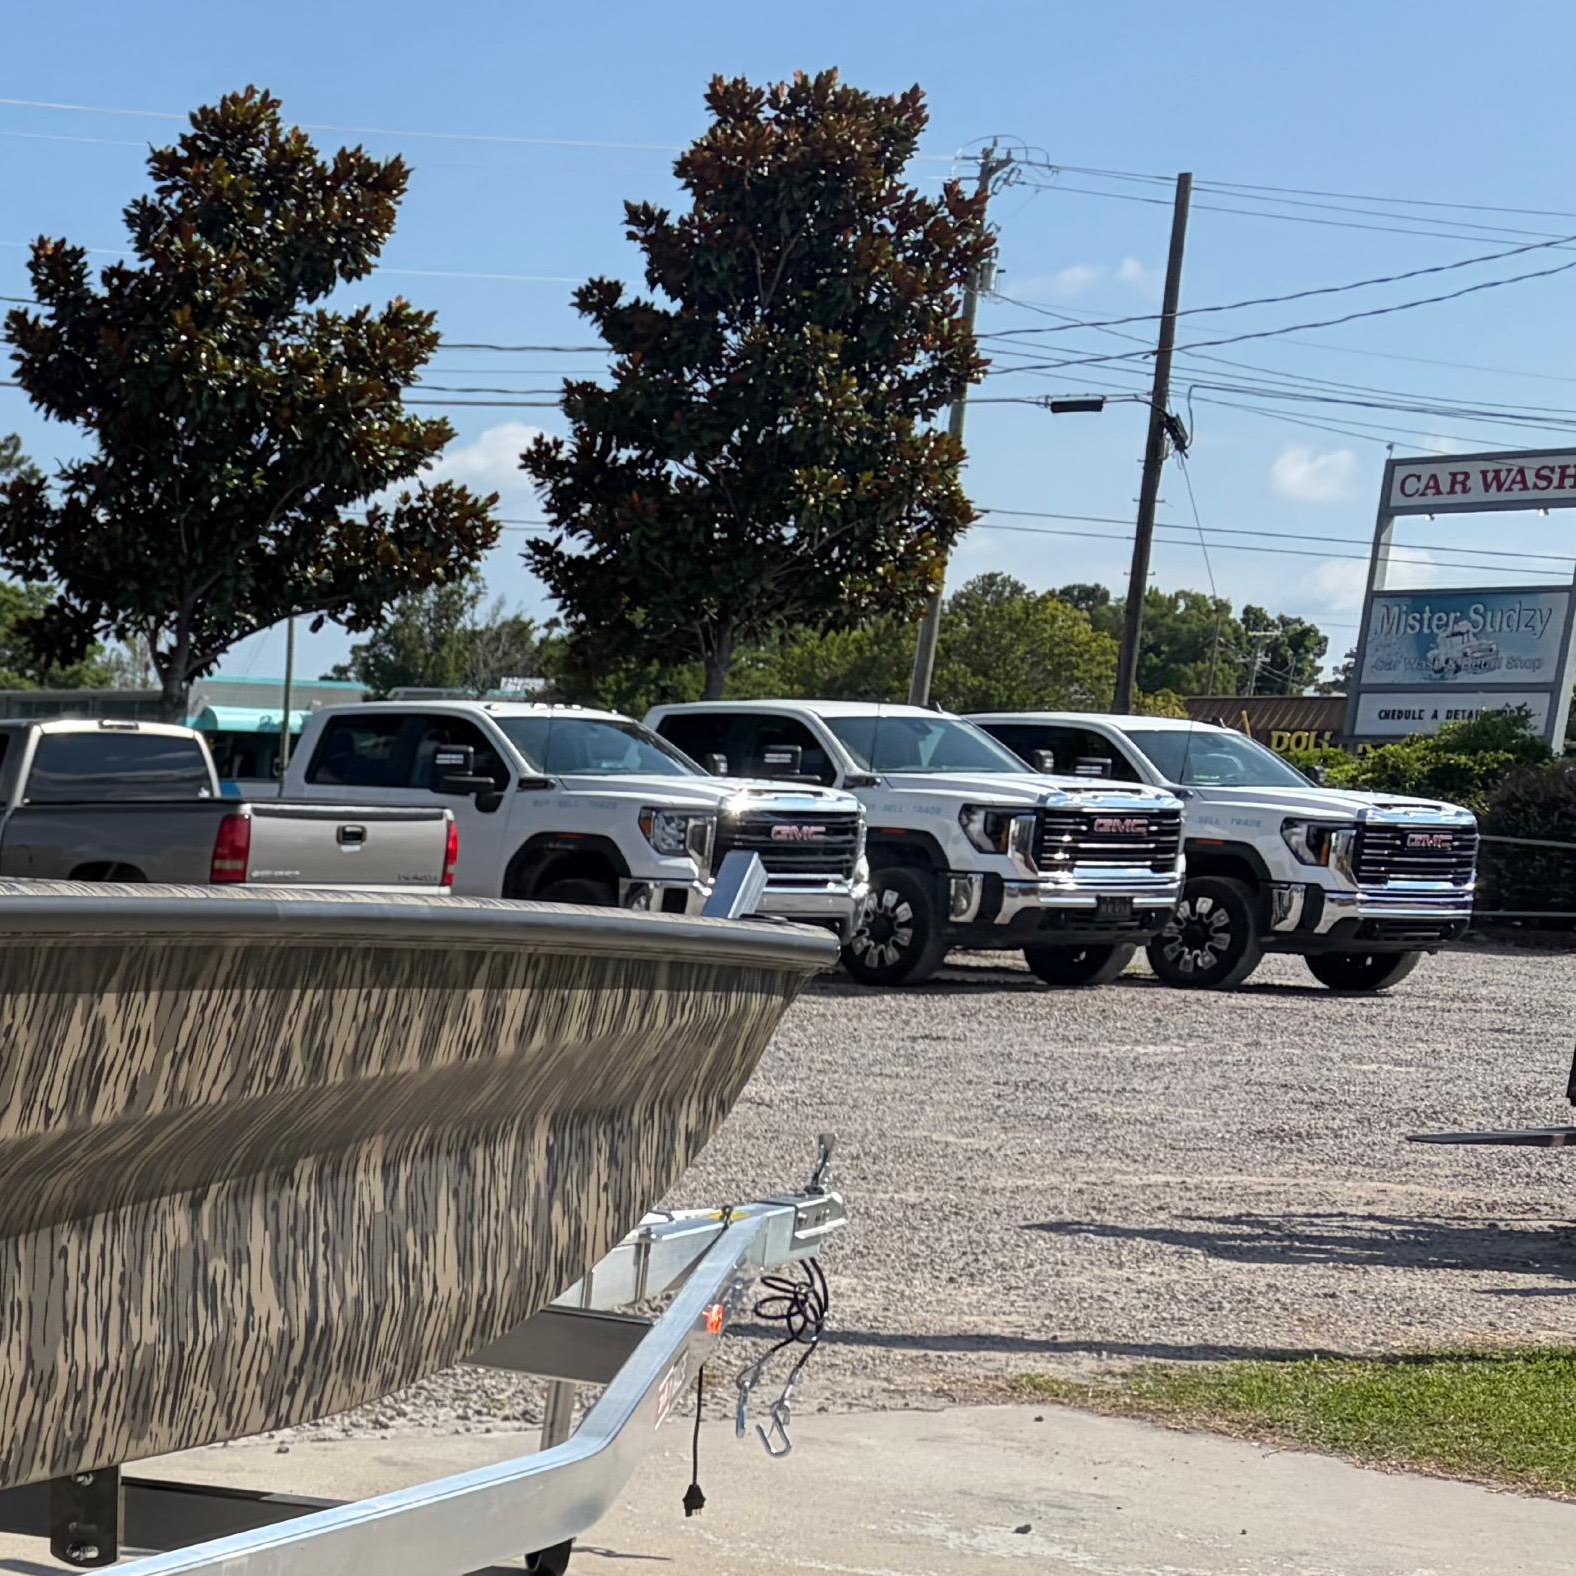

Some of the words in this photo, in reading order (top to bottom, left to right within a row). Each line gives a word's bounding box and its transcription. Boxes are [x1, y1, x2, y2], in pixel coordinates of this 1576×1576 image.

[1399, 472, 1472, 498] CAR
[1479, 463, 1576, 494] WASH
[1376, 604, 1461, 636] Mister
[1470, 600, 1553, 640] Sudzy
[1505, 655, 1544, 673] Shop
[1430, 708, 1439, 720] A
[1094, 818, 1149, 835] GMC
[1230, 818, 1262, 828] TRADE
[770, 825, 827, 841] GMC
[1406, 833, 1453, 849] GMC
